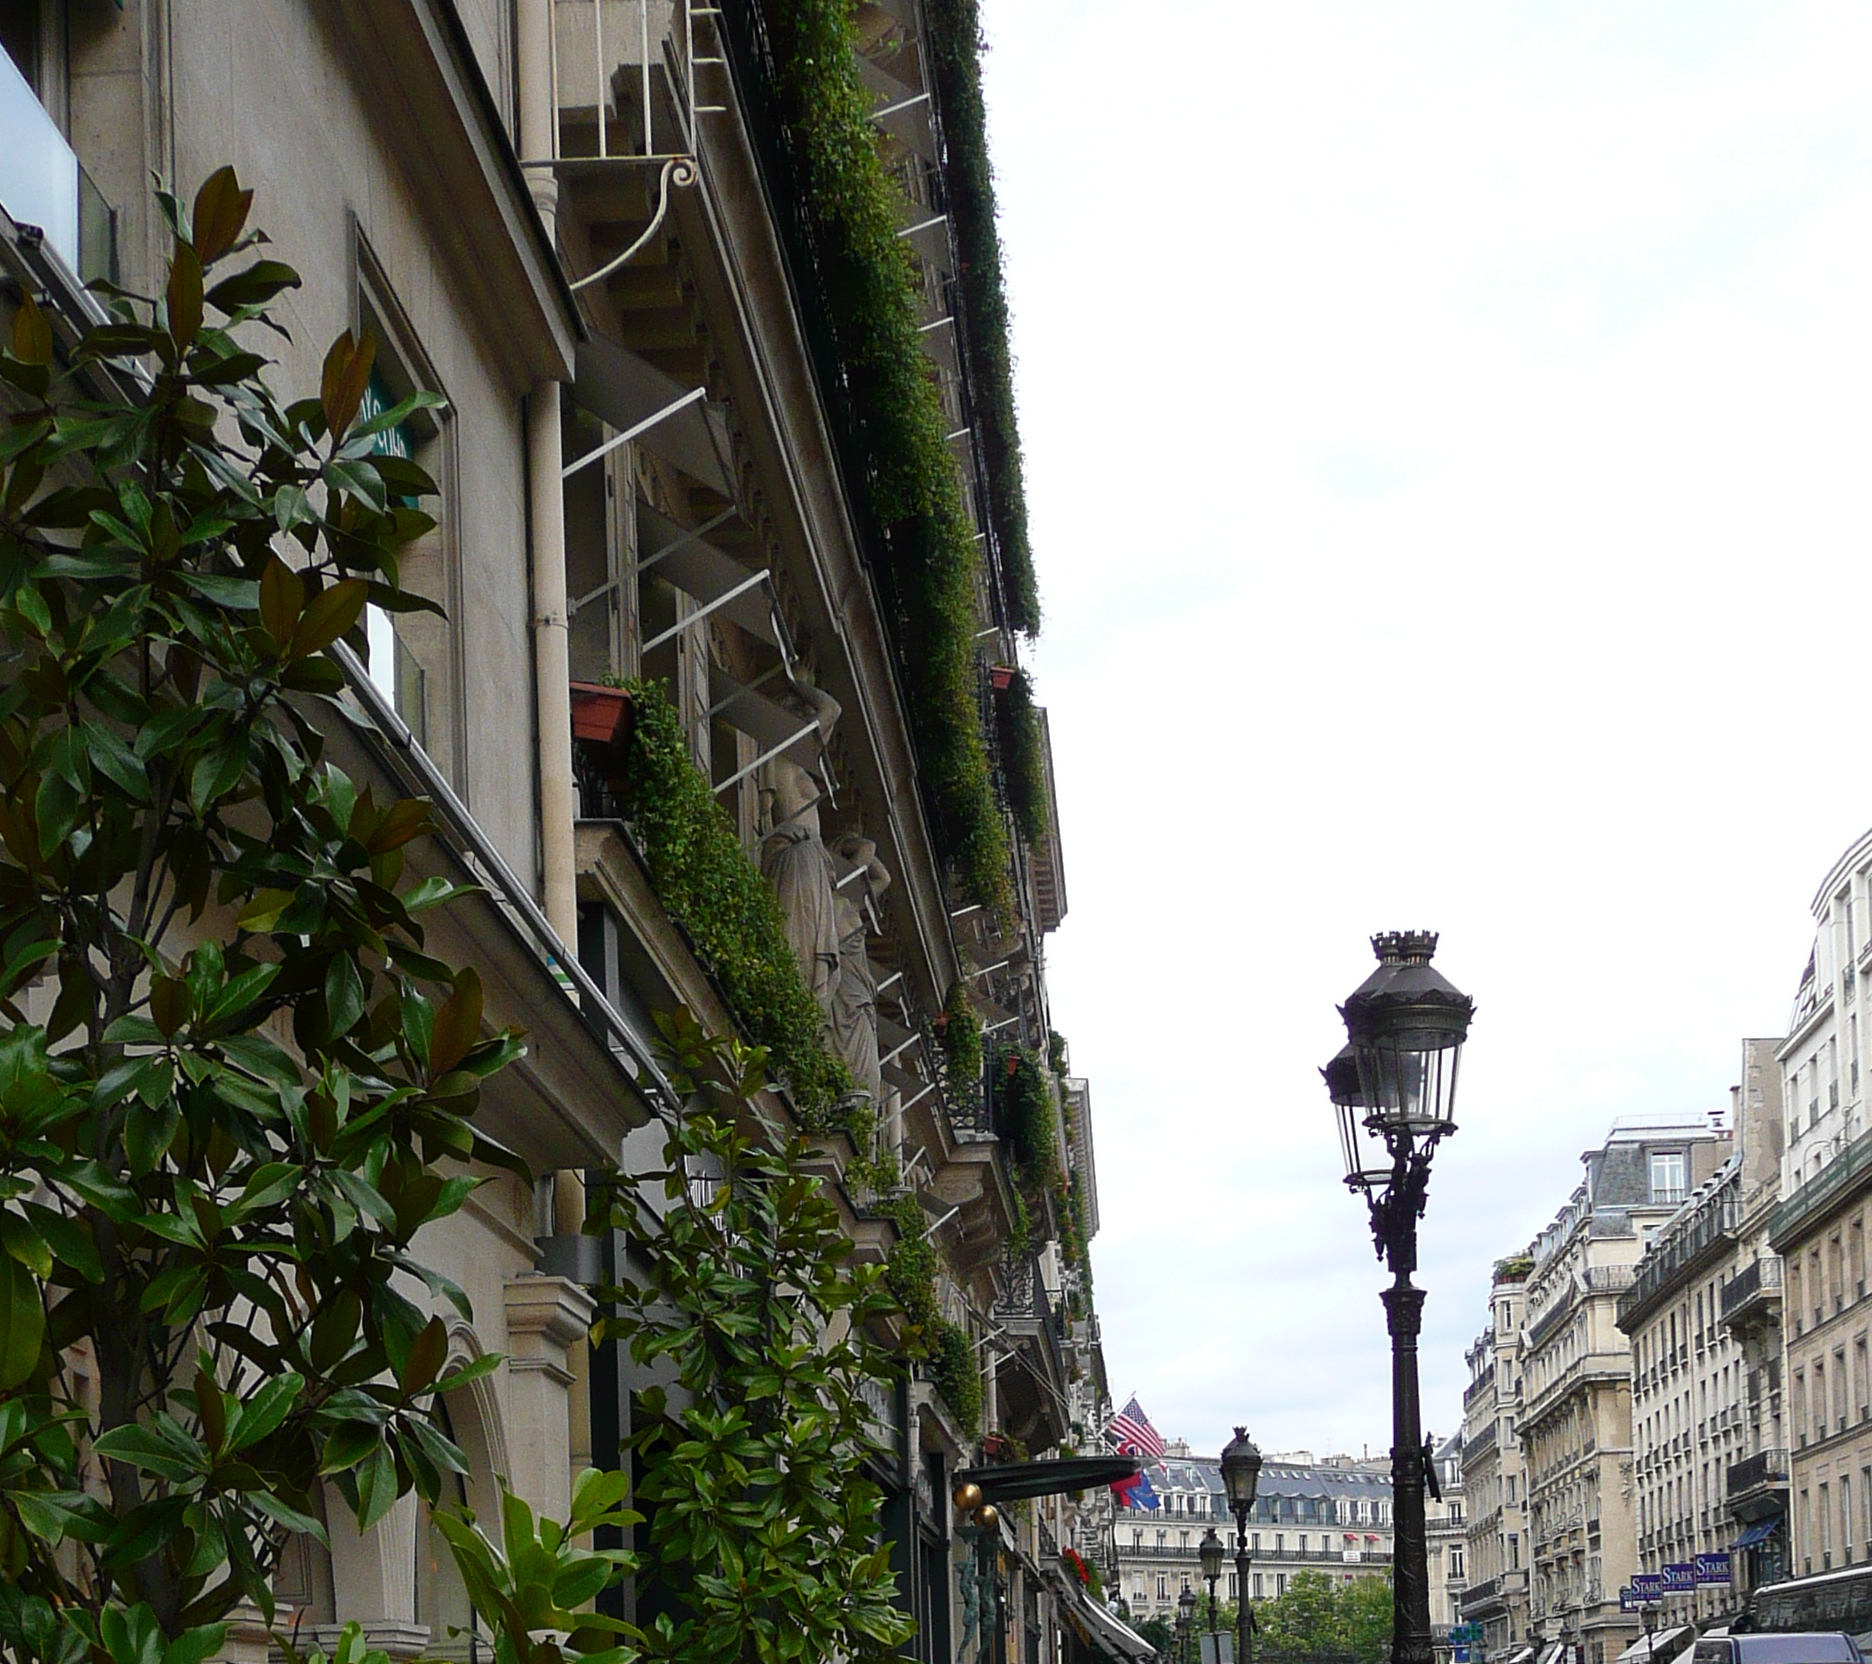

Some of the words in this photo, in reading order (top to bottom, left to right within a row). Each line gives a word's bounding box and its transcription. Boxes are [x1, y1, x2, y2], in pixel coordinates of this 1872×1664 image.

[1697, 1557, 1729, 1575] STARK
[1662, 1567, 1694, 1584] STARK
[1632, 1578, 1661, 1594] STARK
